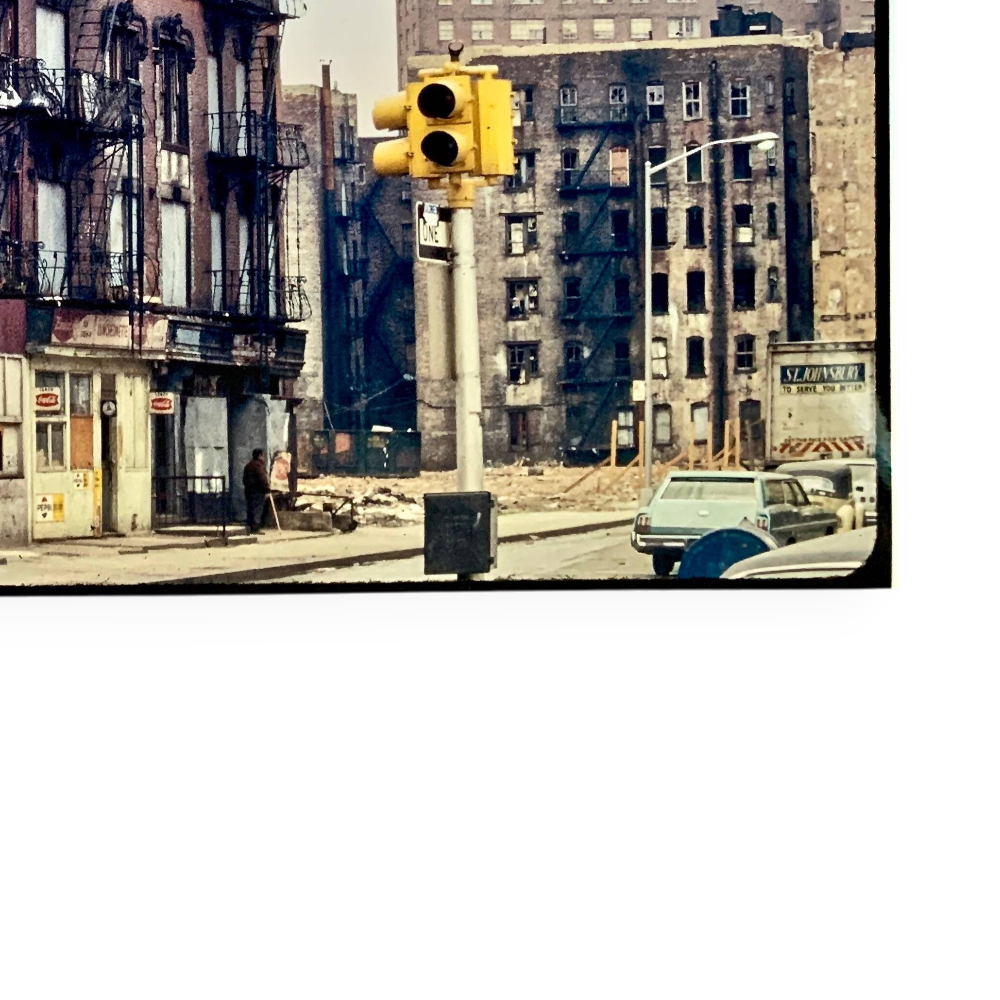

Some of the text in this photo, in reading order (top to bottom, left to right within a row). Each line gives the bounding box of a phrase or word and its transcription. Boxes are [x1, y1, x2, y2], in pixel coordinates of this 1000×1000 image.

[423, 226, 439, 243] ONE
[796, 385, 817, 393] SERVE
[822, 384, 836, 392] YOU
